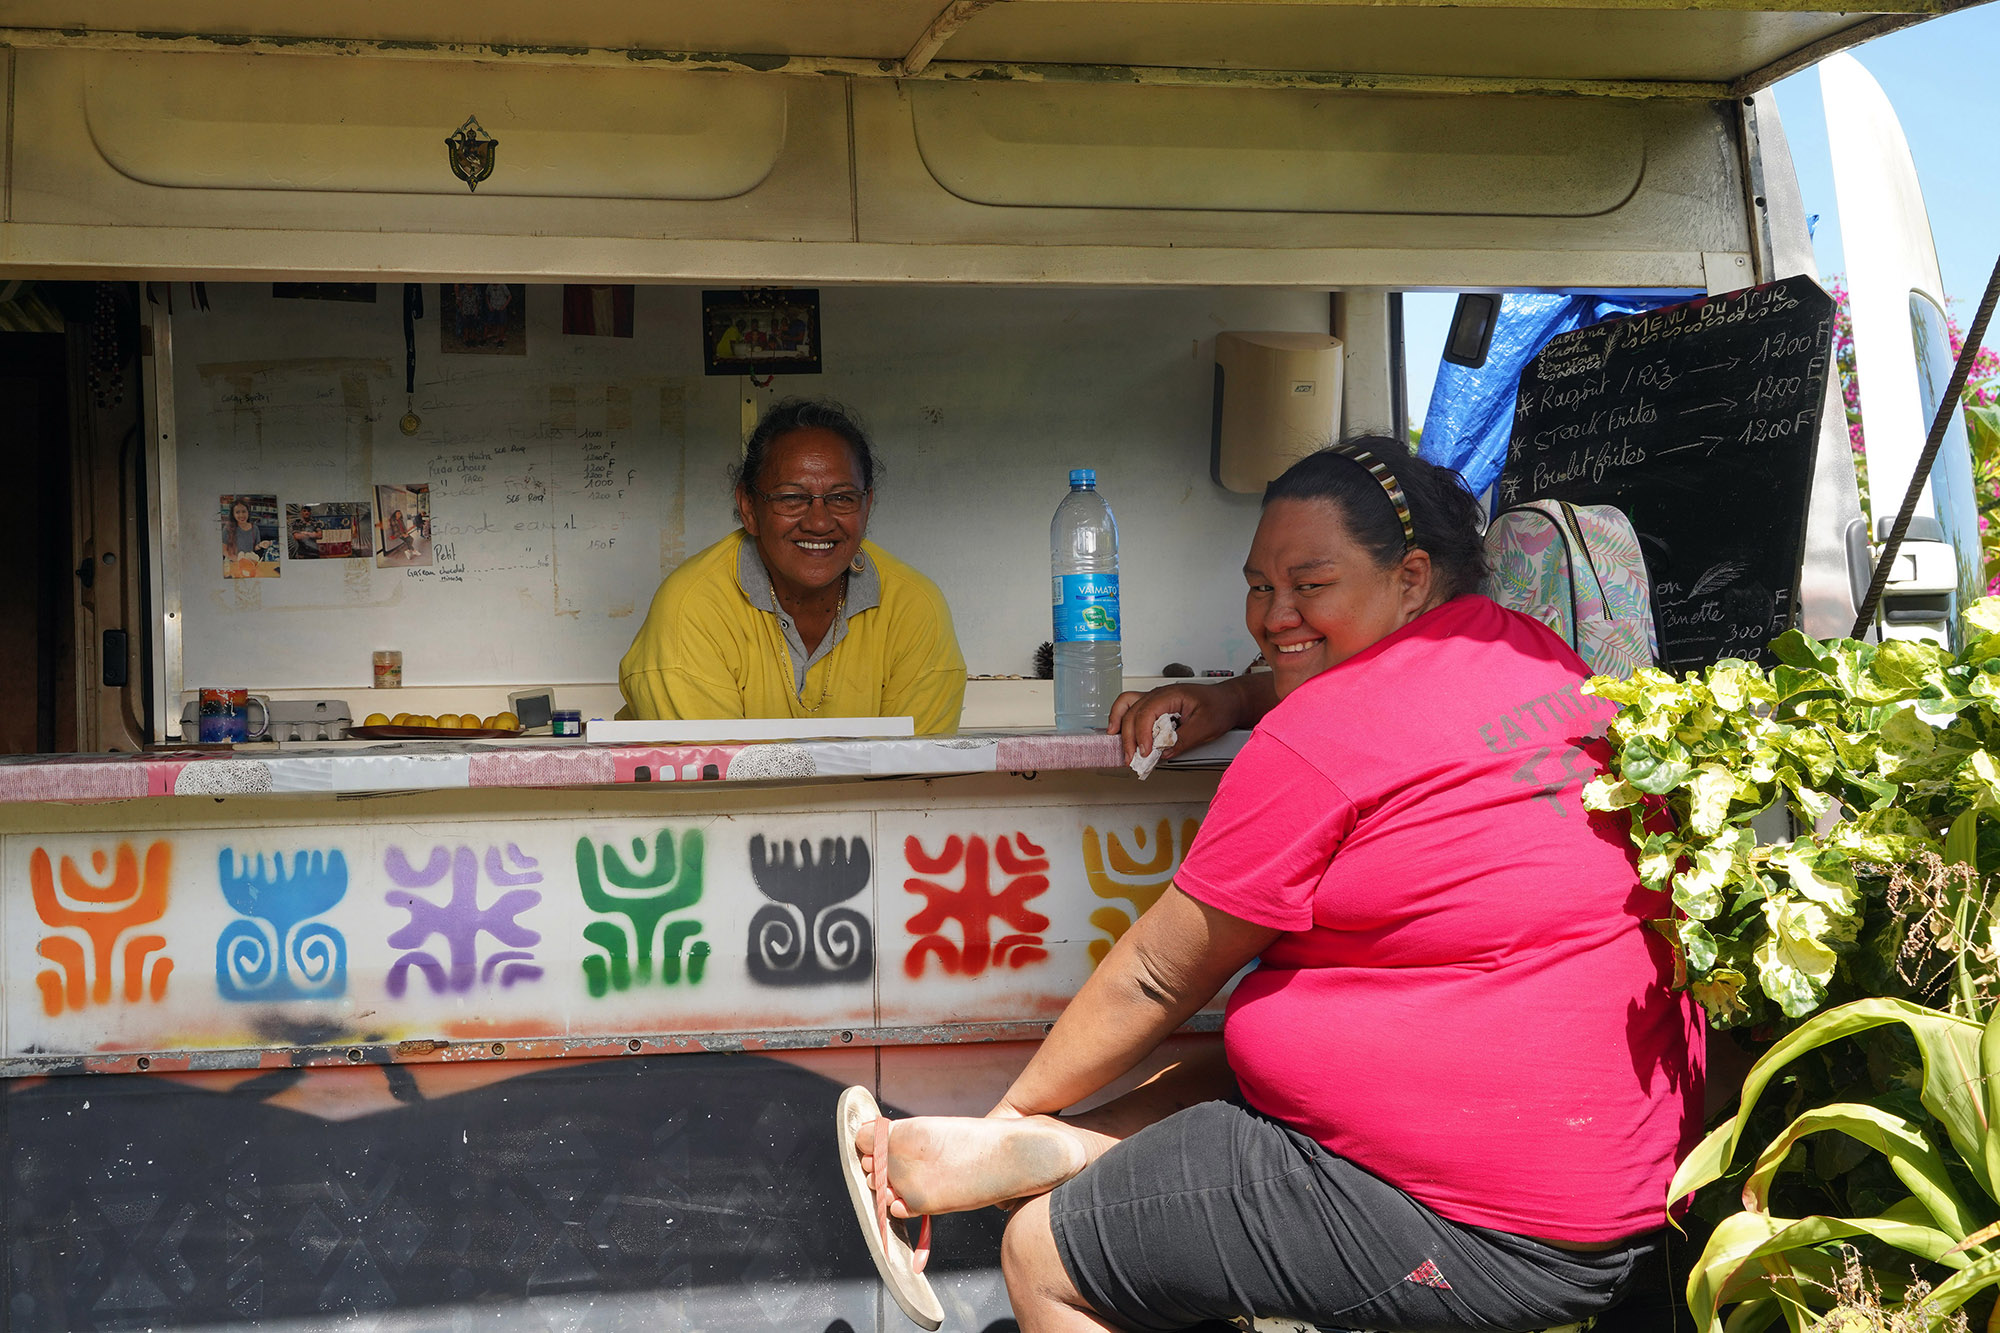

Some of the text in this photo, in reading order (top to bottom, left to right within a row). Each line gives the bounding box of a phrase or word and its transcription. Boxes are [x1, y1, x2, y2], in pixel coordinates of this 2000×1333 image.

[1701, 301, 1726, 320] DU
[1750, 331, 1811, 365] 1200
[1746, 376, 1800, 403] 1200
[1739, 419, 1795, 445] 1200
[585, 478, 613, 488] 1000
[1078, 585, 1117, 594] VAIMATO
[1725, 623, 1763, 642] 300
